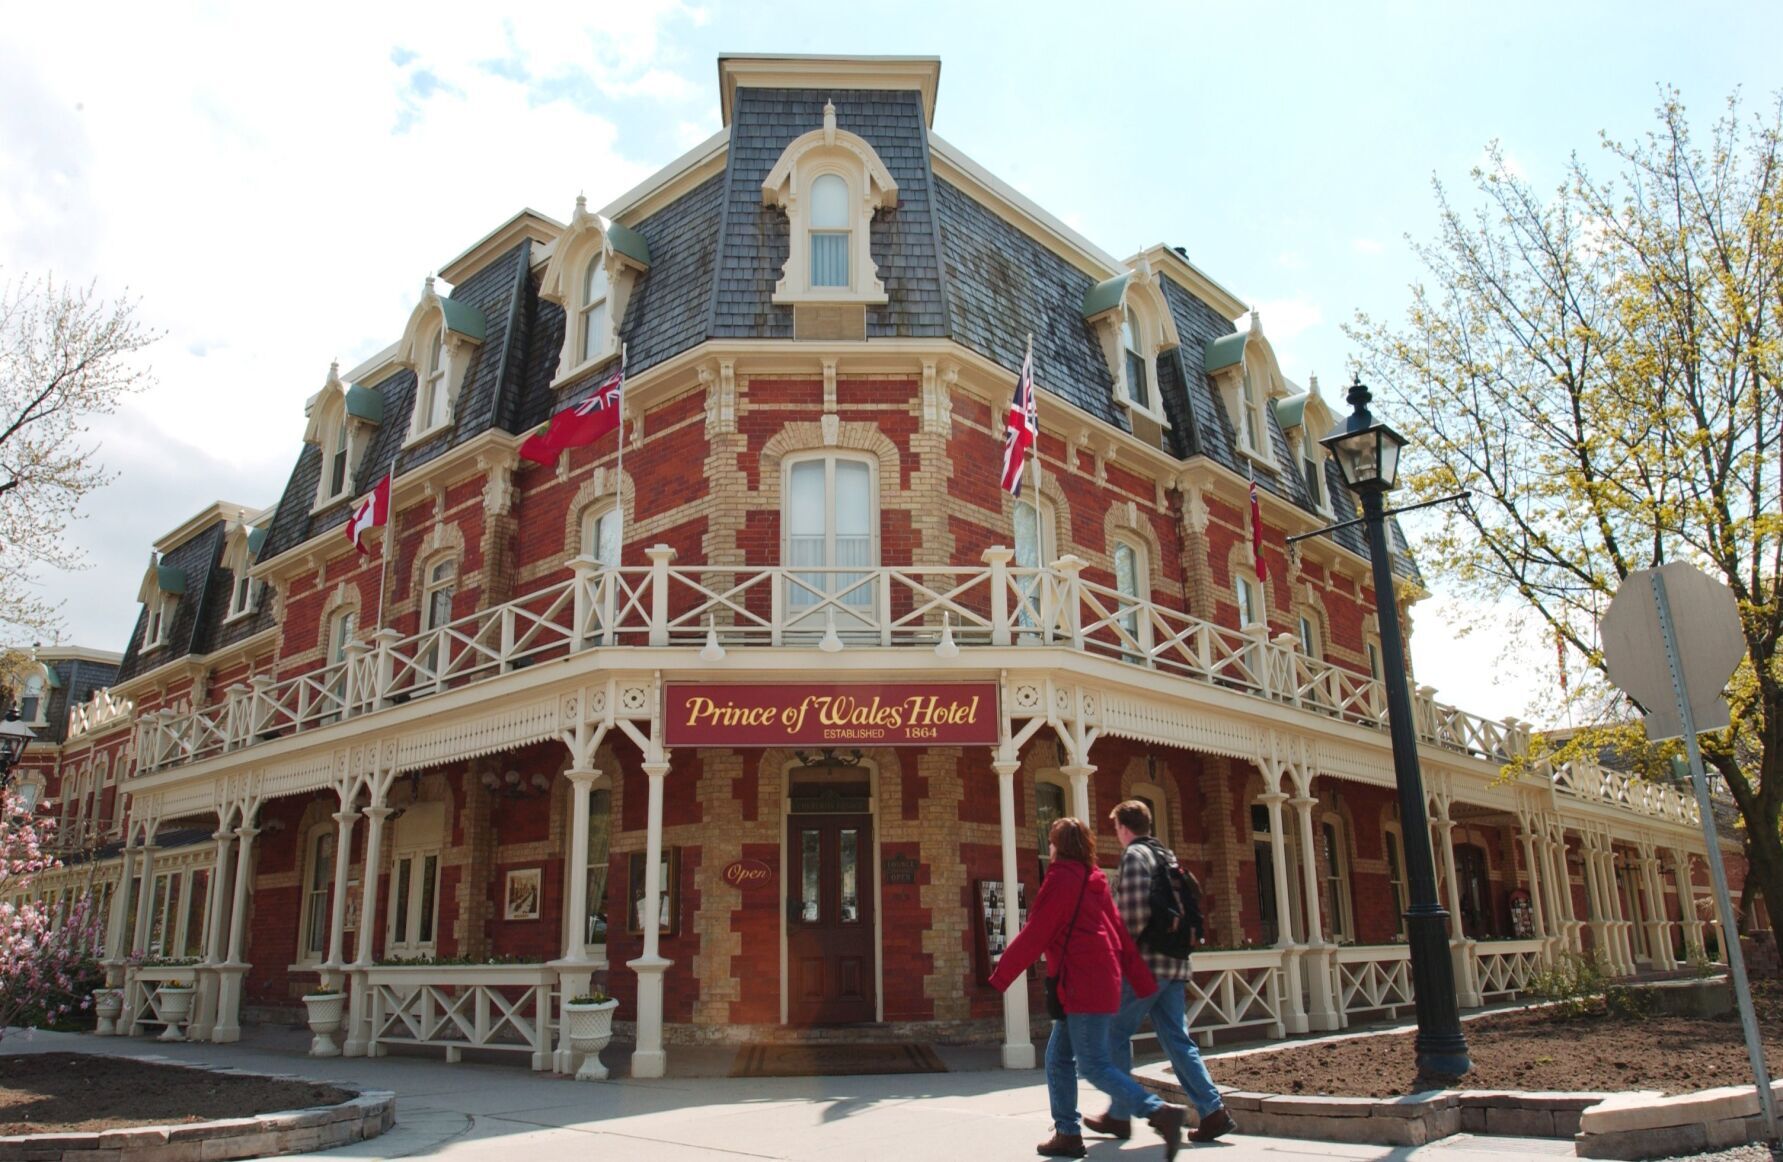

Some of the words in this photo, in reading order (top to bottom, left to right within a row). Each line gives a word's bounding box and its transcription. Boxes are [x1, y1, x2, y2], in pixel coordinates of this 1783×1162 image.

[685, 697, 777, 726] Prince
[781, 695, 816, 734] of
[814, 695, 903, 729] Wales
[903, 695, 980, 725] Hotel
[823, 728, 885, 739] ESTABLISHED
[904, 727, 938, 739] 1864
[727, 863, 767, 885] Open
